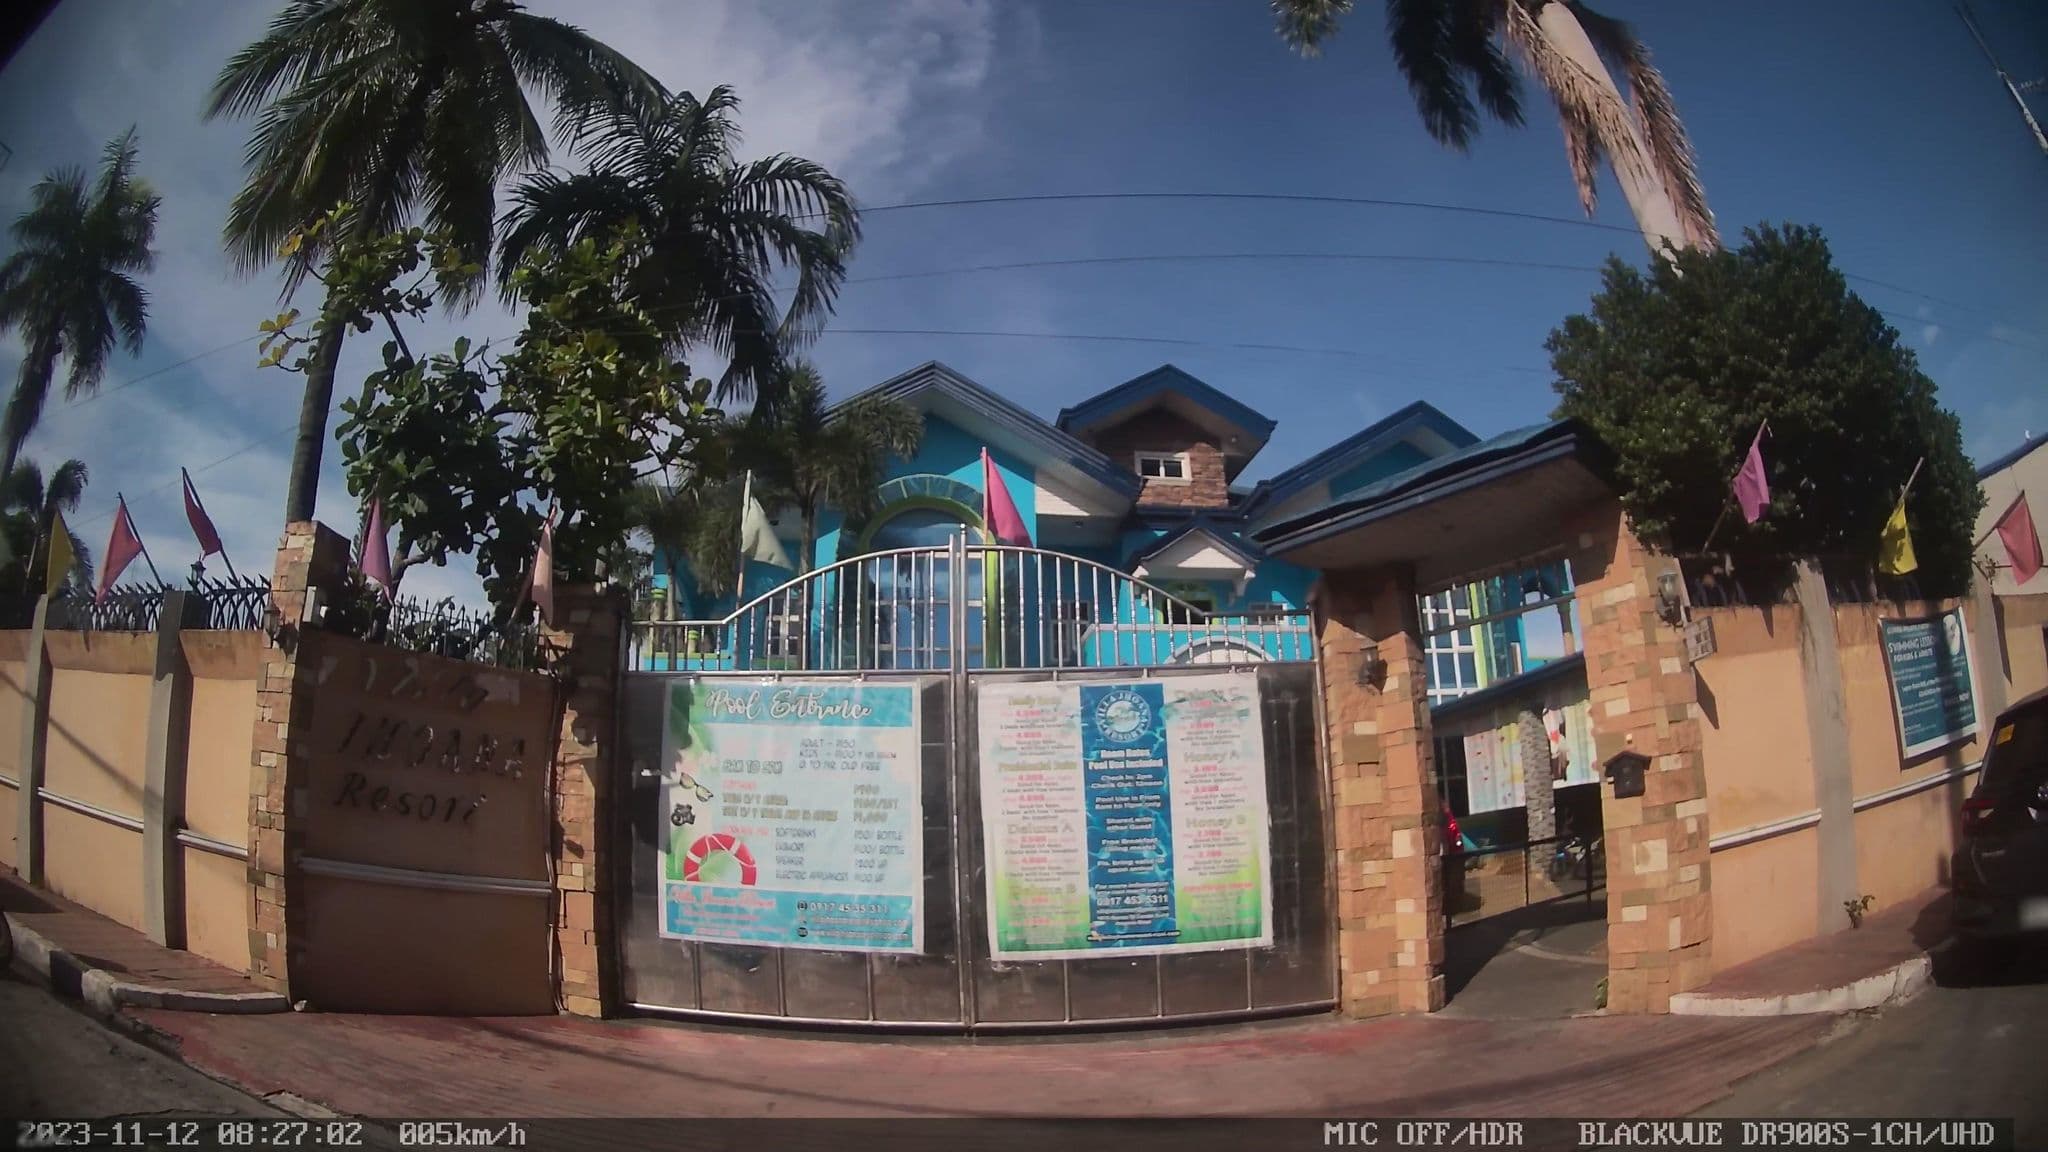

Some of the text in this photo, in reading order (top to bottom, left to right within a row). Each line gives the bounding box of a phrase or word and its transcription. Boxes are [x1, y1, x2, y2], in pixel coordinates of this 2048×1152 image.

[706, 690, 872, 720] Pool Entrance
[809, 903, 834, 912] 0917
